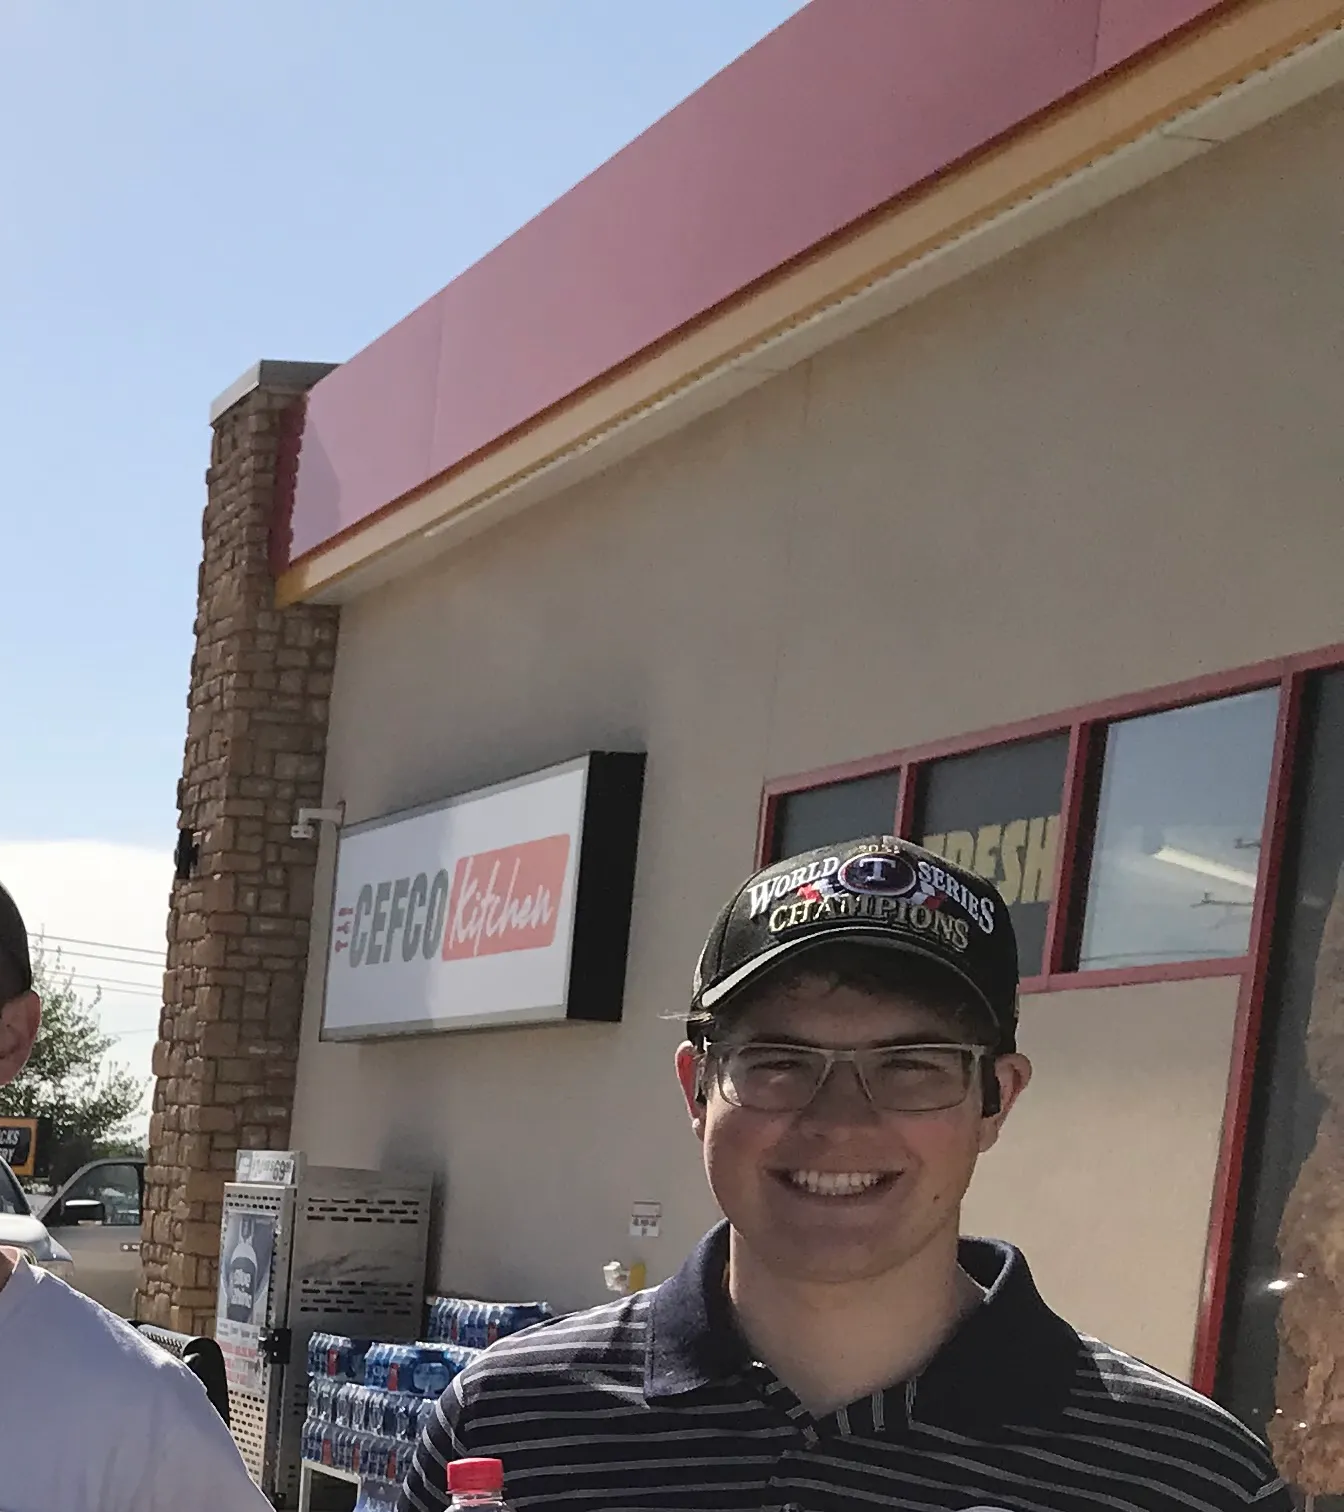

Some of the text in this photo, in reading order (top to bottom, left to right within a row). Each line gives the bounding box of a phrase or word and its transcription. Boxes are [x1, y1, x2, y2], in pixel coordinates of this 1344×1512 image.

[747, 856, 839, 920] WORLD
[859, 857, 896, 883] T
[918, 861, 995, 935] SERIES
[349, 867, 449, 968] CEFCO
[449, 856, 553, 957] Kitchen
[770, 896, 969, 953] CHAMPIONS
